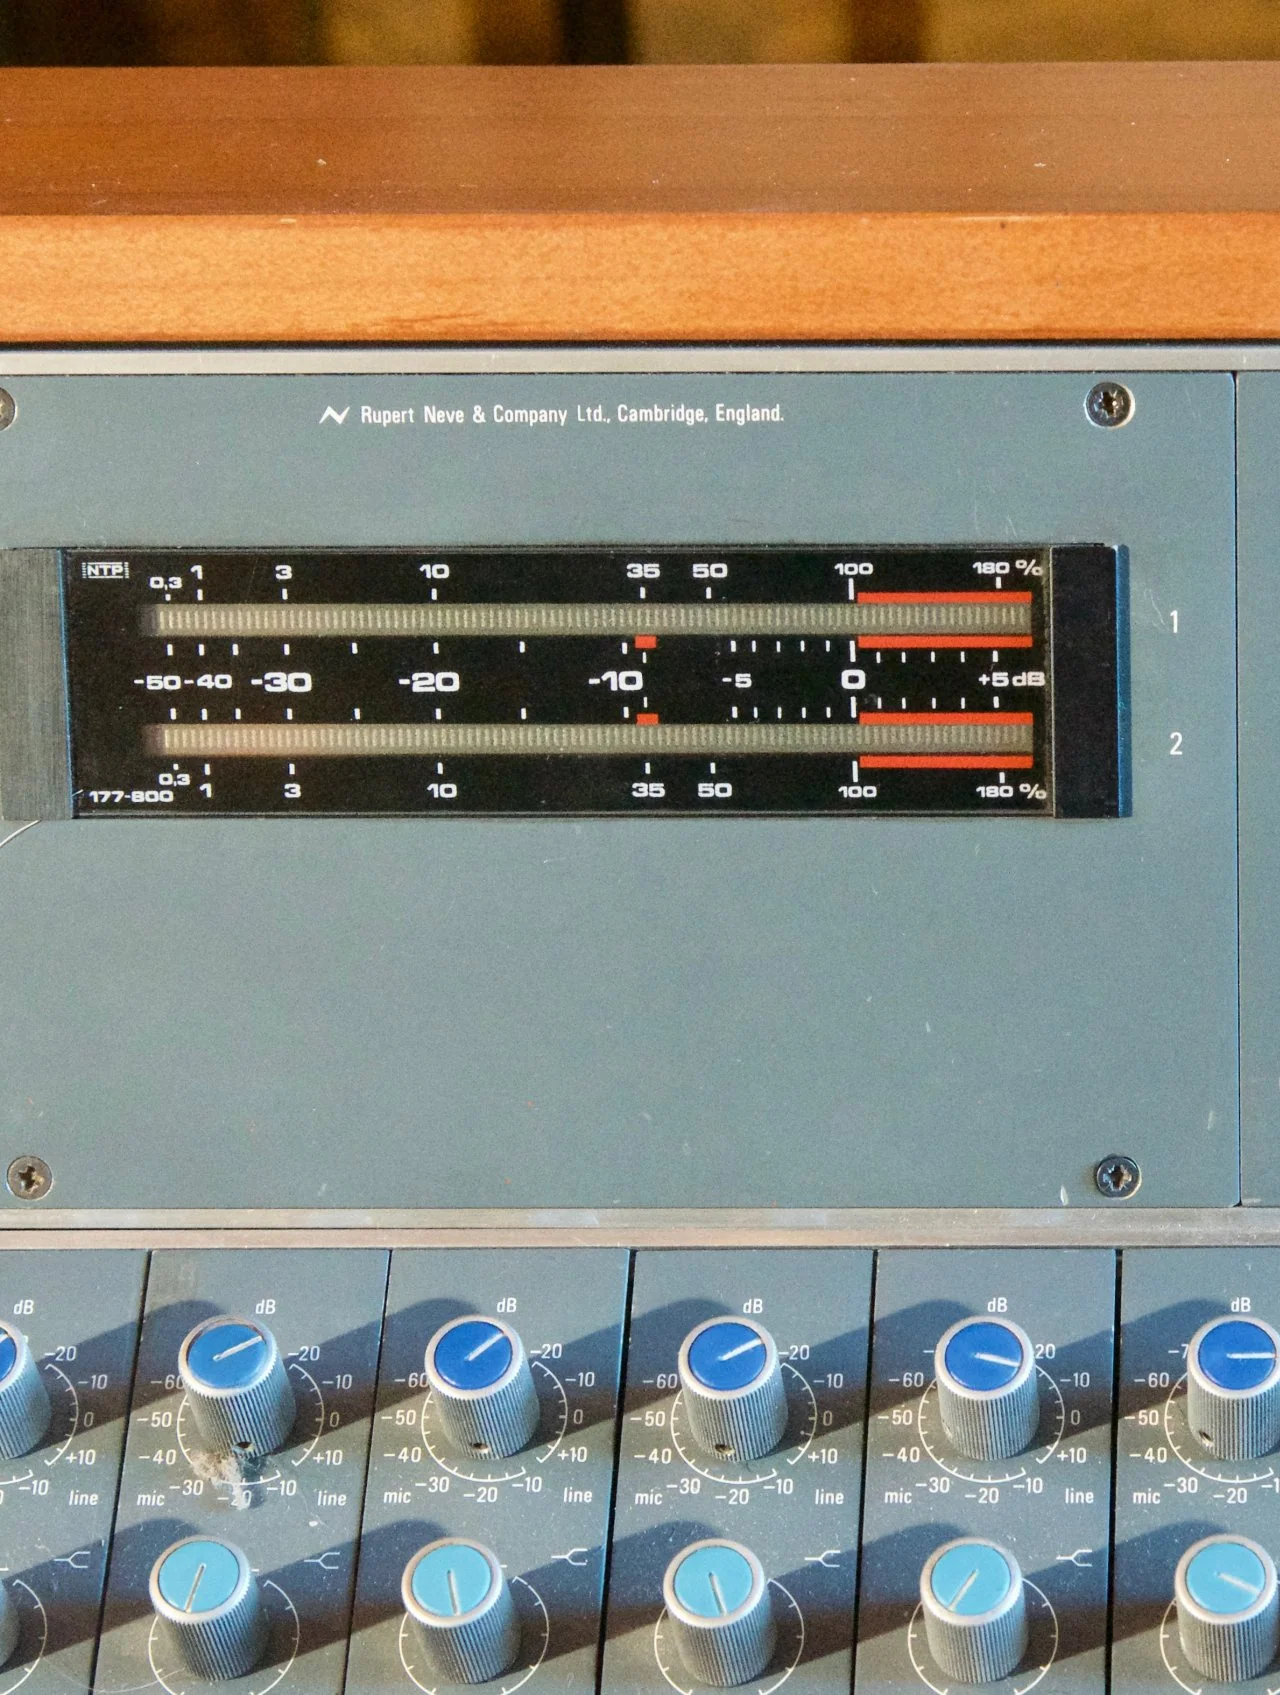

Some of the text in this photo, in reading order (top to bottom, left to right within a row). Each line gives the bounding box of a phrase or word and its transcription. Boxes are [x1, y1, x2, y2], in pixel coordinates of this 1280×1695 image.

[361, 404, 783, 427] Rupert Neve & Company Ltd., Cambridge, England.
[86, 563, 125, 577] NTP
[191, 565, 202, 579] 1
[276, 565, 292, 579] 3
[420, 564, 449, 578] 10
[627, 564, 660, 578] 35
[693, 564, 727, 578] 50
[835, 563, 873, 575] 100
[973, 562, 1009, 574] 180
[1016, 560, 1045, 575] %
[1171, 610, 1177, 633] 1
[134, 670, 1045, 692] -50 -40 -30 -20 -10 -5 0 +5 dB
[1170, 732, 1182, 755] 2
[89, 790, 173, 802] 177-800
[200, 783, 211, 797] 1
[285, 783, 301, 798] 3
[427, 784, 457, 798] 10
[632, 783, 665, 797] 35
[698, 783, 732, 797] 50
[839, 786, 877, 797] 100
[976, 786, 1013, 797] 180
[1019, 784, 1047, 799] %
[14, 1300, 34, 1314] dB
[256, 1299, 275, 1314] dB
[497, 1298, 516, 1312] dB
[743, 1299, 763, 1313] dB
[988, 1297, 1007, 1312] dB
[1231, 1297, 1251, 1312] dB
[45, 1346, 76, 1361] -20
[137, 1412, 172, 1427] -50
[381, 1410, 416, 1425] -50
[627, 1410, 665, 1426] -50
[875, 1410, 912, 1425] -50
[1121, 1410, 1158, 1425] -50
[66, 1449, 96, 1465] +10
[139, 1449, 176, 1465] -40
[313, 1450, 342, 1465] +10
[384, 1447, 421, 1462] -40
[558, 1447, 587, 1462] +10
[634, 1448, 671, 1464] -40
[808, 1448, 837, 1464] +10
[883, 1447, 920, 1462] -40
[1057, 1447, 1086, 1463] +10
[1130, 1447, 1167, 1463] -40
[169, 1480, 203, 1495] -30
[415, 1476, 449, 1492] -30
[667, 1478, 700, 1494] -30
[916, 1477, 950, 1493] -30
[1164, 1477, 1197, 1493] -30
[69, 1490, 98, 1505] line
[137, 1495, 165, 1506] mic
[318, 1490, 346, 1505] line
[384, 1492, 411, 1503] mic
[464, 1487, 497, 1502] -20
[564, 1487, 592, 1503] line
[635, 1489, 662, 1505] mic
[716, 1489, 749, 1504] -20
[816, 1489, 844, 1504] line
[885, 1488, 912, 1503] mic
[965, 1488, 999, 1503] -20
[1066, 1488, 1094, 1503] line
[1133, 1488, 1160, 1504] mic
[1214, 1488, 1247, 1503] -20
